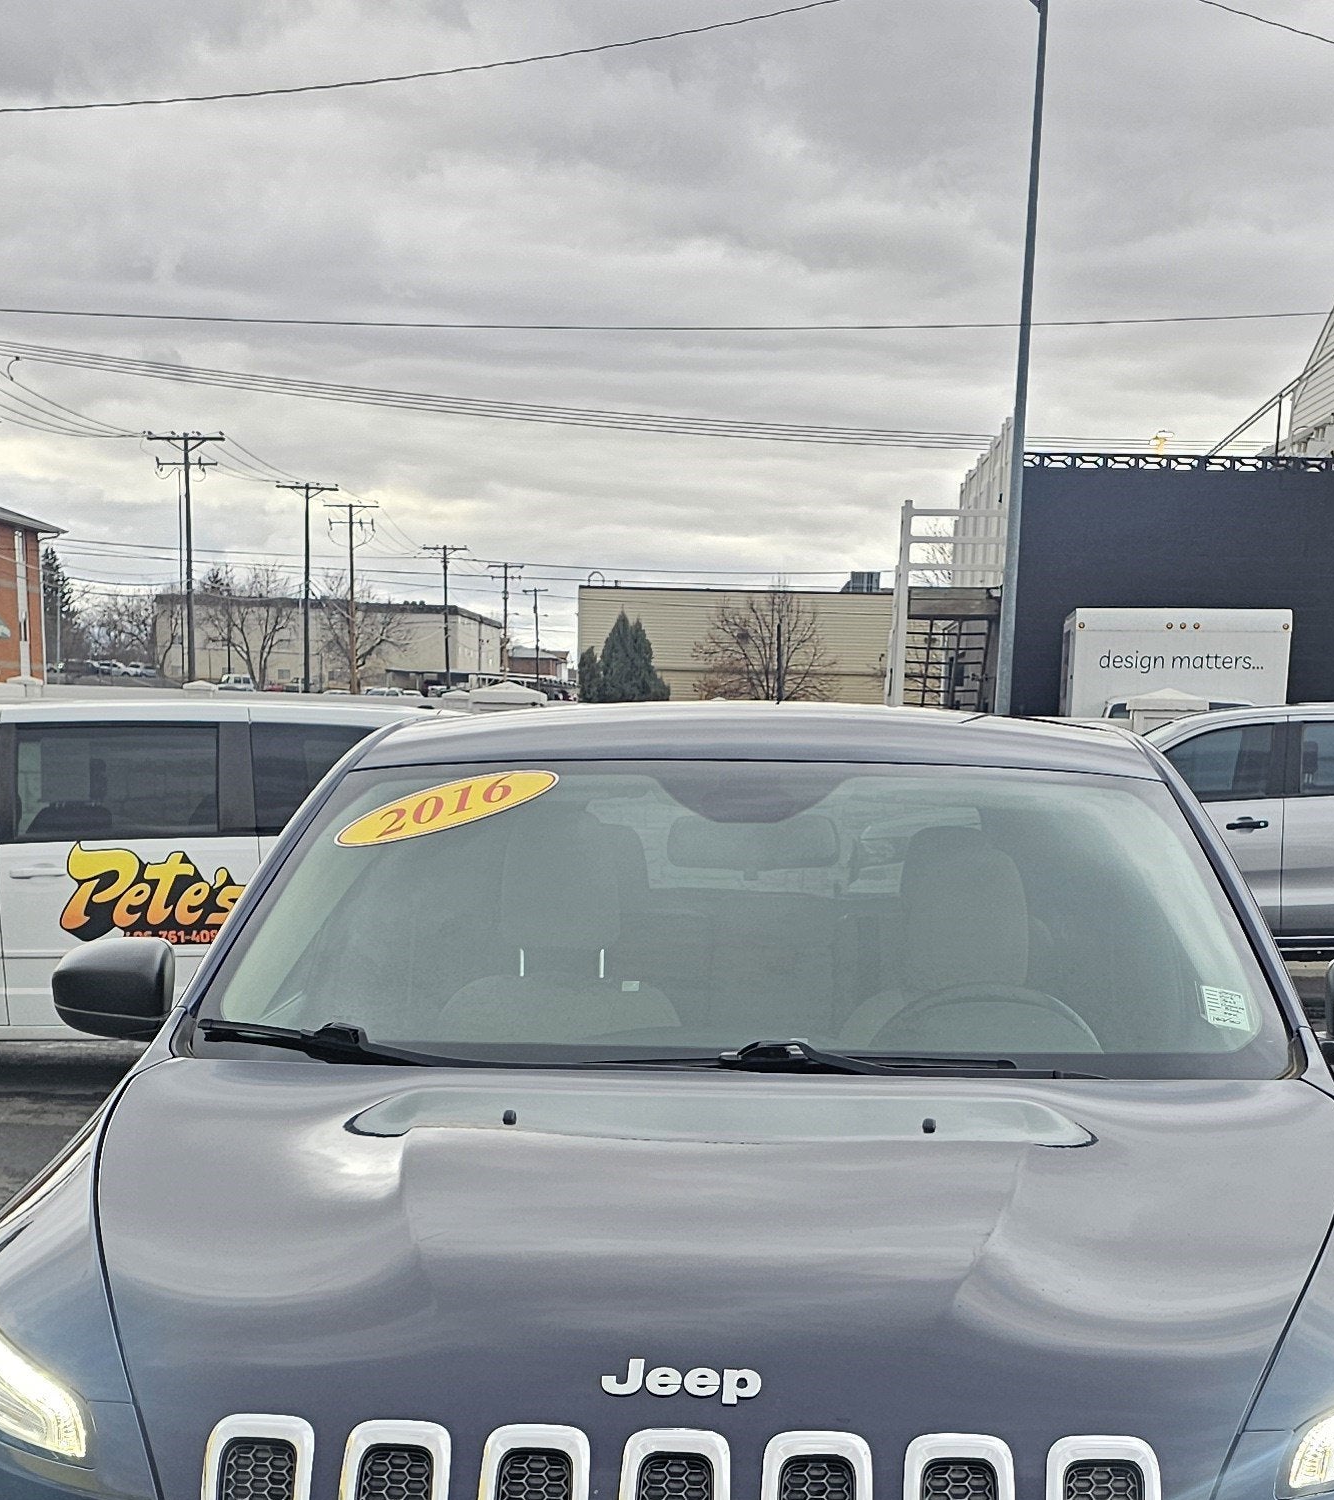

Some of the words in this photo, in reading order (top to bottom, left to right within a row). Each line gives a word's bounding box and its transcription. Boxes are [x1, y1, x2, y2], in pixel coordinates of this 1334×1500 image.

[1099, 649, 1165, 674] design
[1171, 653, 1264, 670] matters...
[376, 774, 514, 838] 2016
[60, 841, 246, 931] Pete's
[601, 1358, 762, 1405] Jeep
